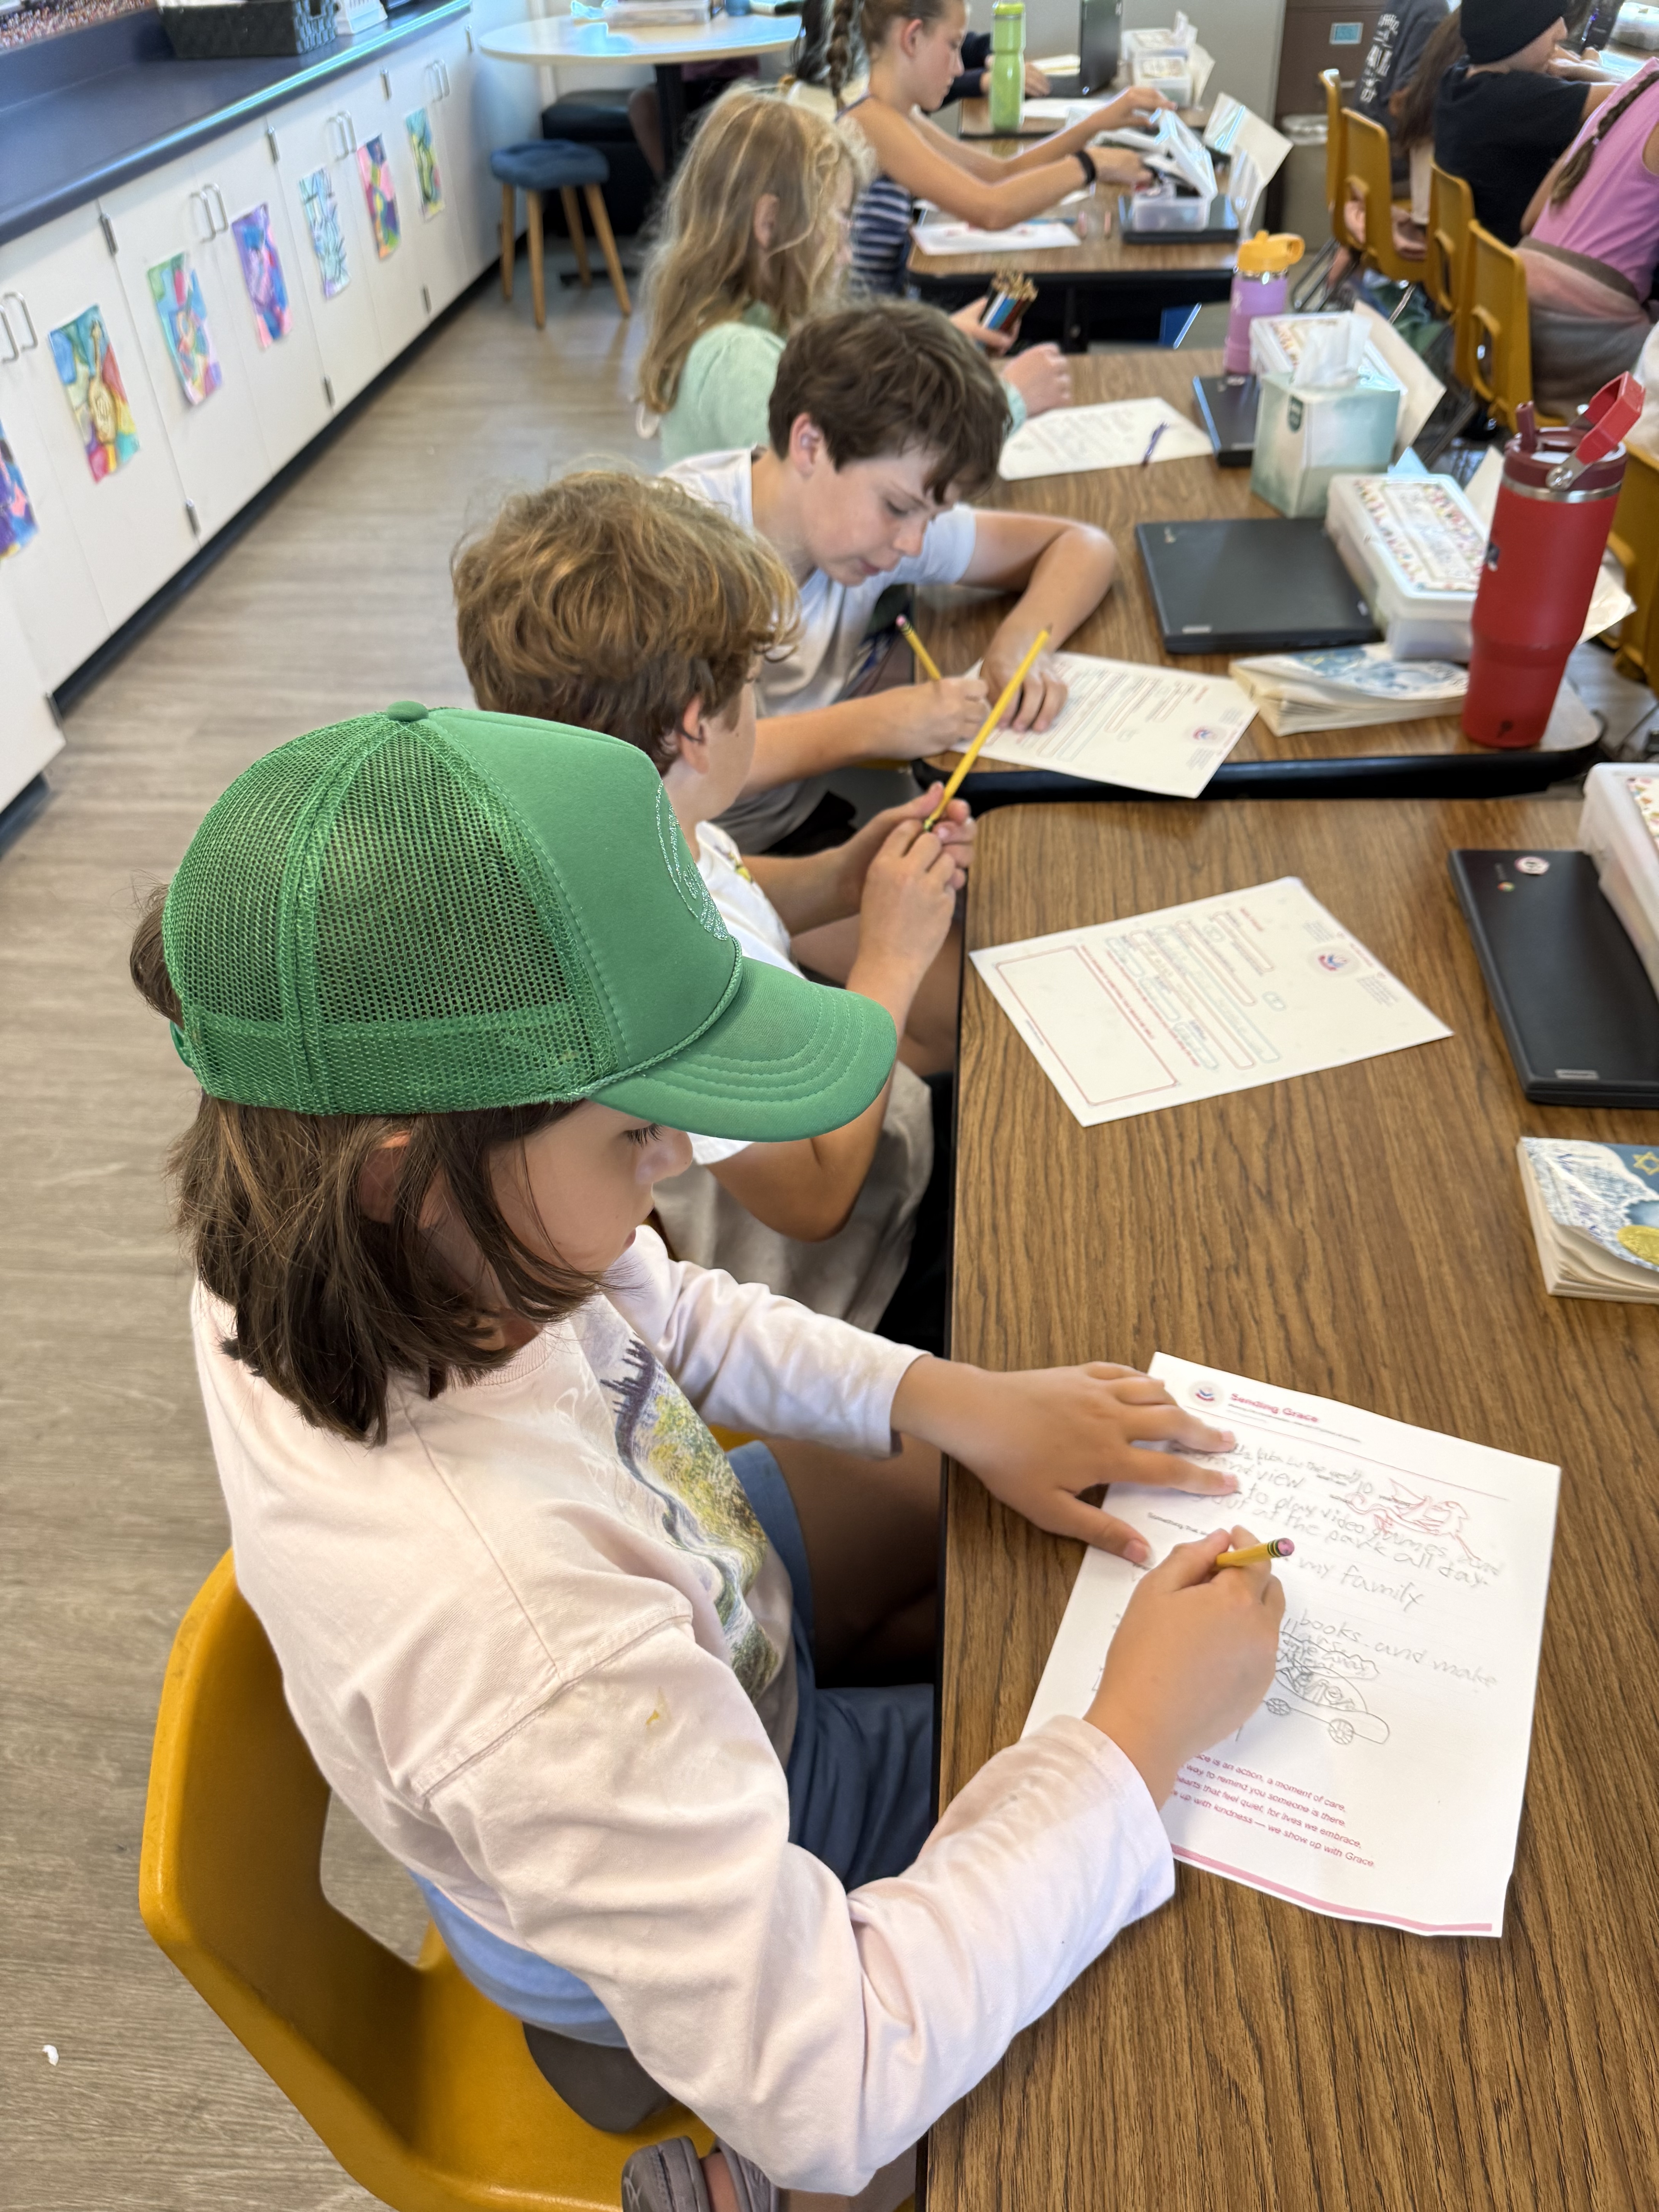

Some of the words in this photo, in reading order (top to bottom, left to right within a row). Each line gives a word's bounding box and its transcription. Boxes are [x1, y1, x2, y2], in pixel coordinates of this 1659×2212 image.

[1231, 1393, 1279, 1414] Sending
[1283, 1407, 1319, 1422] Grace
[1249, 1483, 1269, 1504] to
[1321, 1507, 1365, 1534] video
[1286, 1511, 1320, 1536] the
[1325, 1530, 1386, 1557] park
[1394, 1552, 1431, 1569] all
[1299, 1558, 1335, 1579] my
[1300, 1609, 1362, 1642] books
[1375, 1642, 1427, 1664] and
[1187, 1764, 1204, 1776] way
[1217, 1776, 1248, 1791] remind
[1249, 1786, 1266, 1798] you
[1267, 1793, 1309, 1812] someone
[1312, 1808, 1319, 1817] is
[1203, 1785, 1221, 1796] that
[1222, 1791, 1240, 1803] feel
[1267, 1807, 1280, 1818] for
[1281, 1812, 1302, 1826] lives
[1305, 1822, 1318, 1832] we
[1275, 1781, 1312, 1799] moment
[1180, 1793, 1192, 1802] up
[1194, 1797, 1212, 1808] with
[1214, 1804, 1253, 1824] kindness
[1268, 1824, 1281, 1834] we
[1284, 1830, 1308, 1844] show
[1309, 1840, 1322, 1850] up
[1324, 1845, 1343, 1857] with
